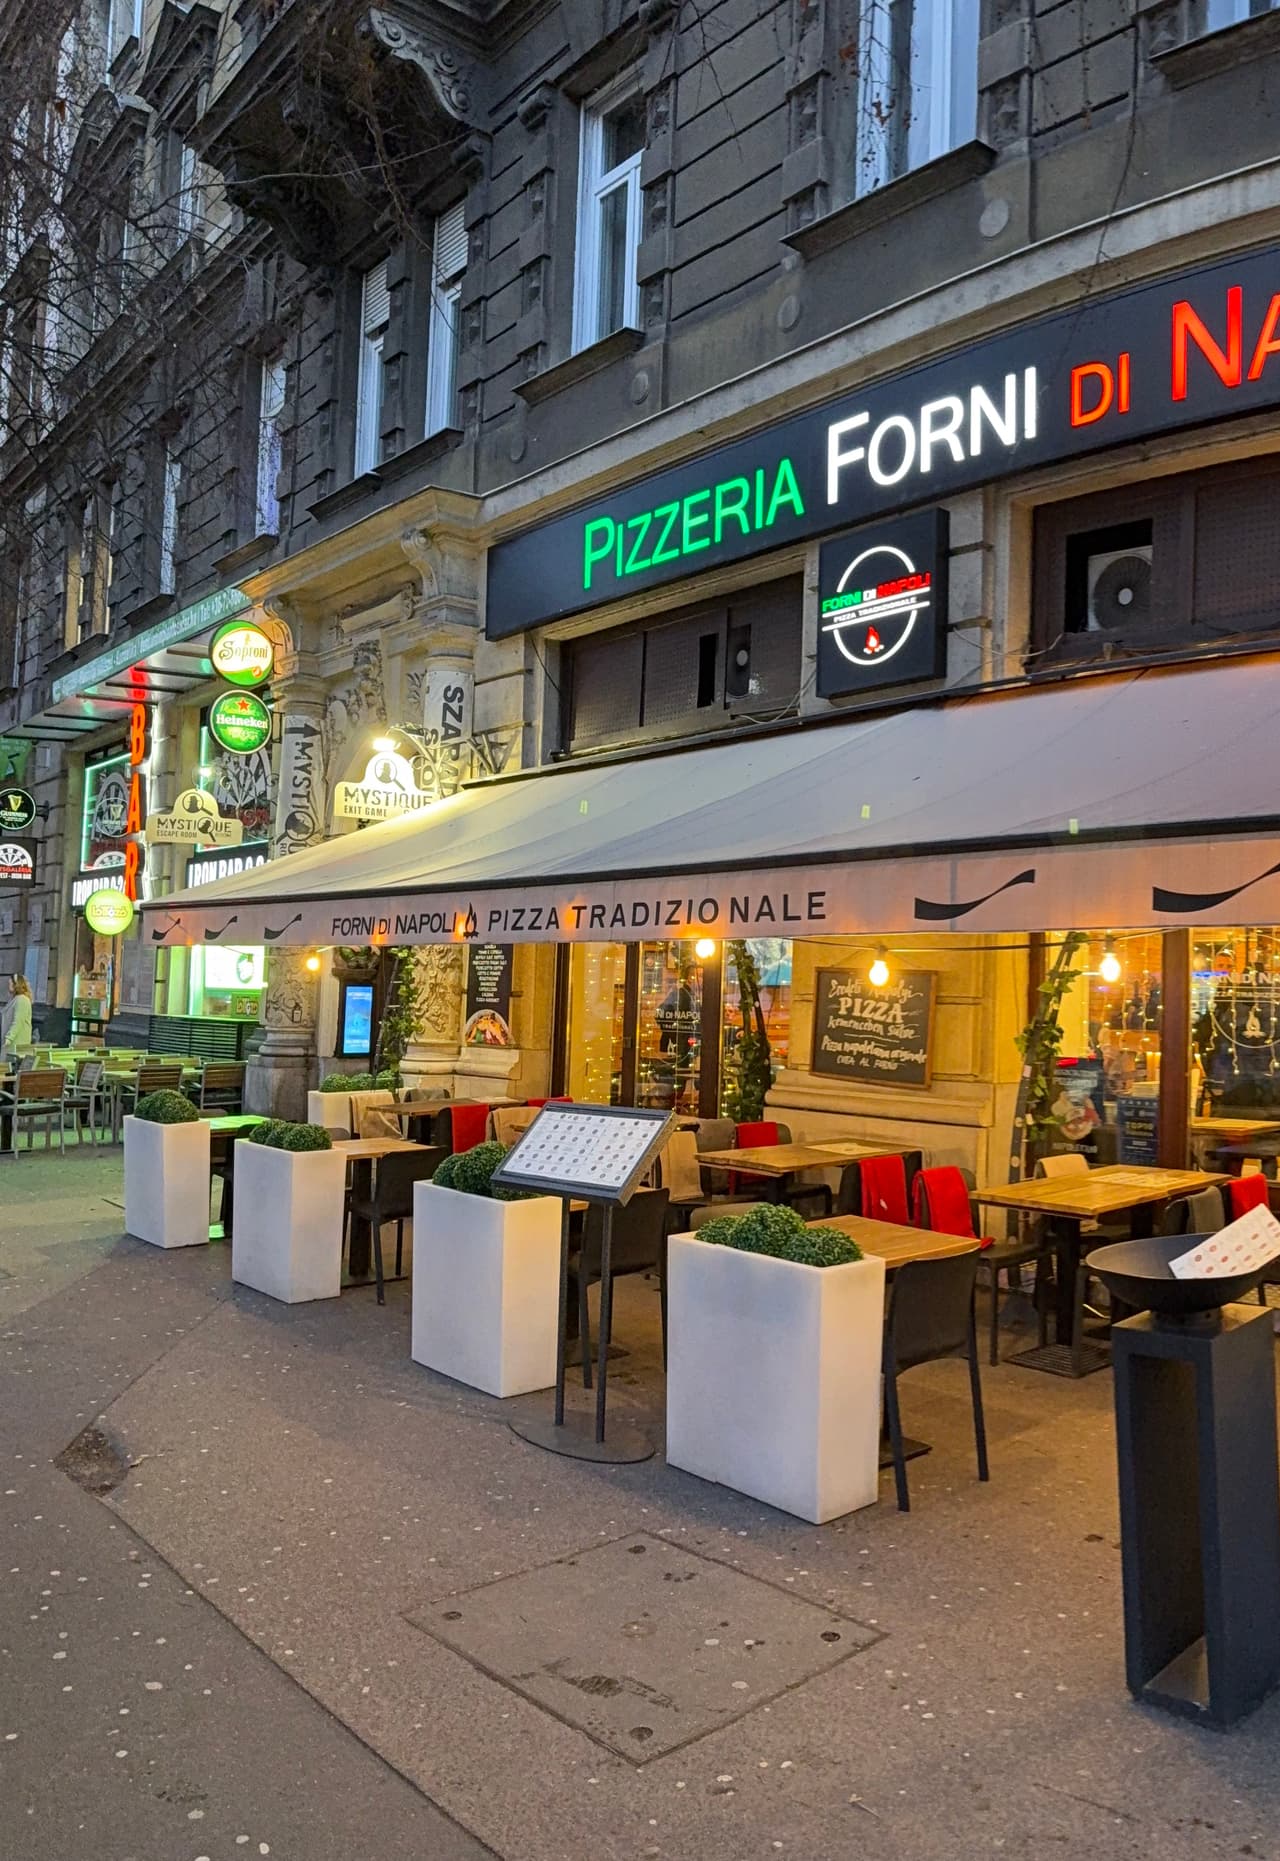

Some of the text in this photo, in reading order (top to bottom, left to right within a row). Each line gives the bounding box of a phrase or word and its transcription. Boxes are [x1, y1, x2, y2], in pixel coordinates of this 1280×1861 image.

[583, 457, 805, 590] PIZZERIA
[826, 366, 1037, 505] FORNI
[1071, 352, 1130, 427] DI
[822, 571, 931, 613] FORNI DI NAPOLI
[833, 612, 857, 623] PIZZA
[218, 640, 268, 661] Soproni
[216, 713, 268, 729] Heineken
[124, 703, 146, 902] BAR
[277, 741, 315, 856] MYSTIQU
[344, 786, 433, 810] MYSTIQUE
[344, 805, 387, 817] EXIT GAME
[156, 830, 179, 838] ESCAPE
[157, 817, 232, 842] MYSTIQUE
[332, 891, 826, 936] FORNI DI NAPOLI PIZZA TRADIZIONALE
[674, 1011, 701, 1020] NAPOL
[838, 997, 905, 1023] PIZZA
